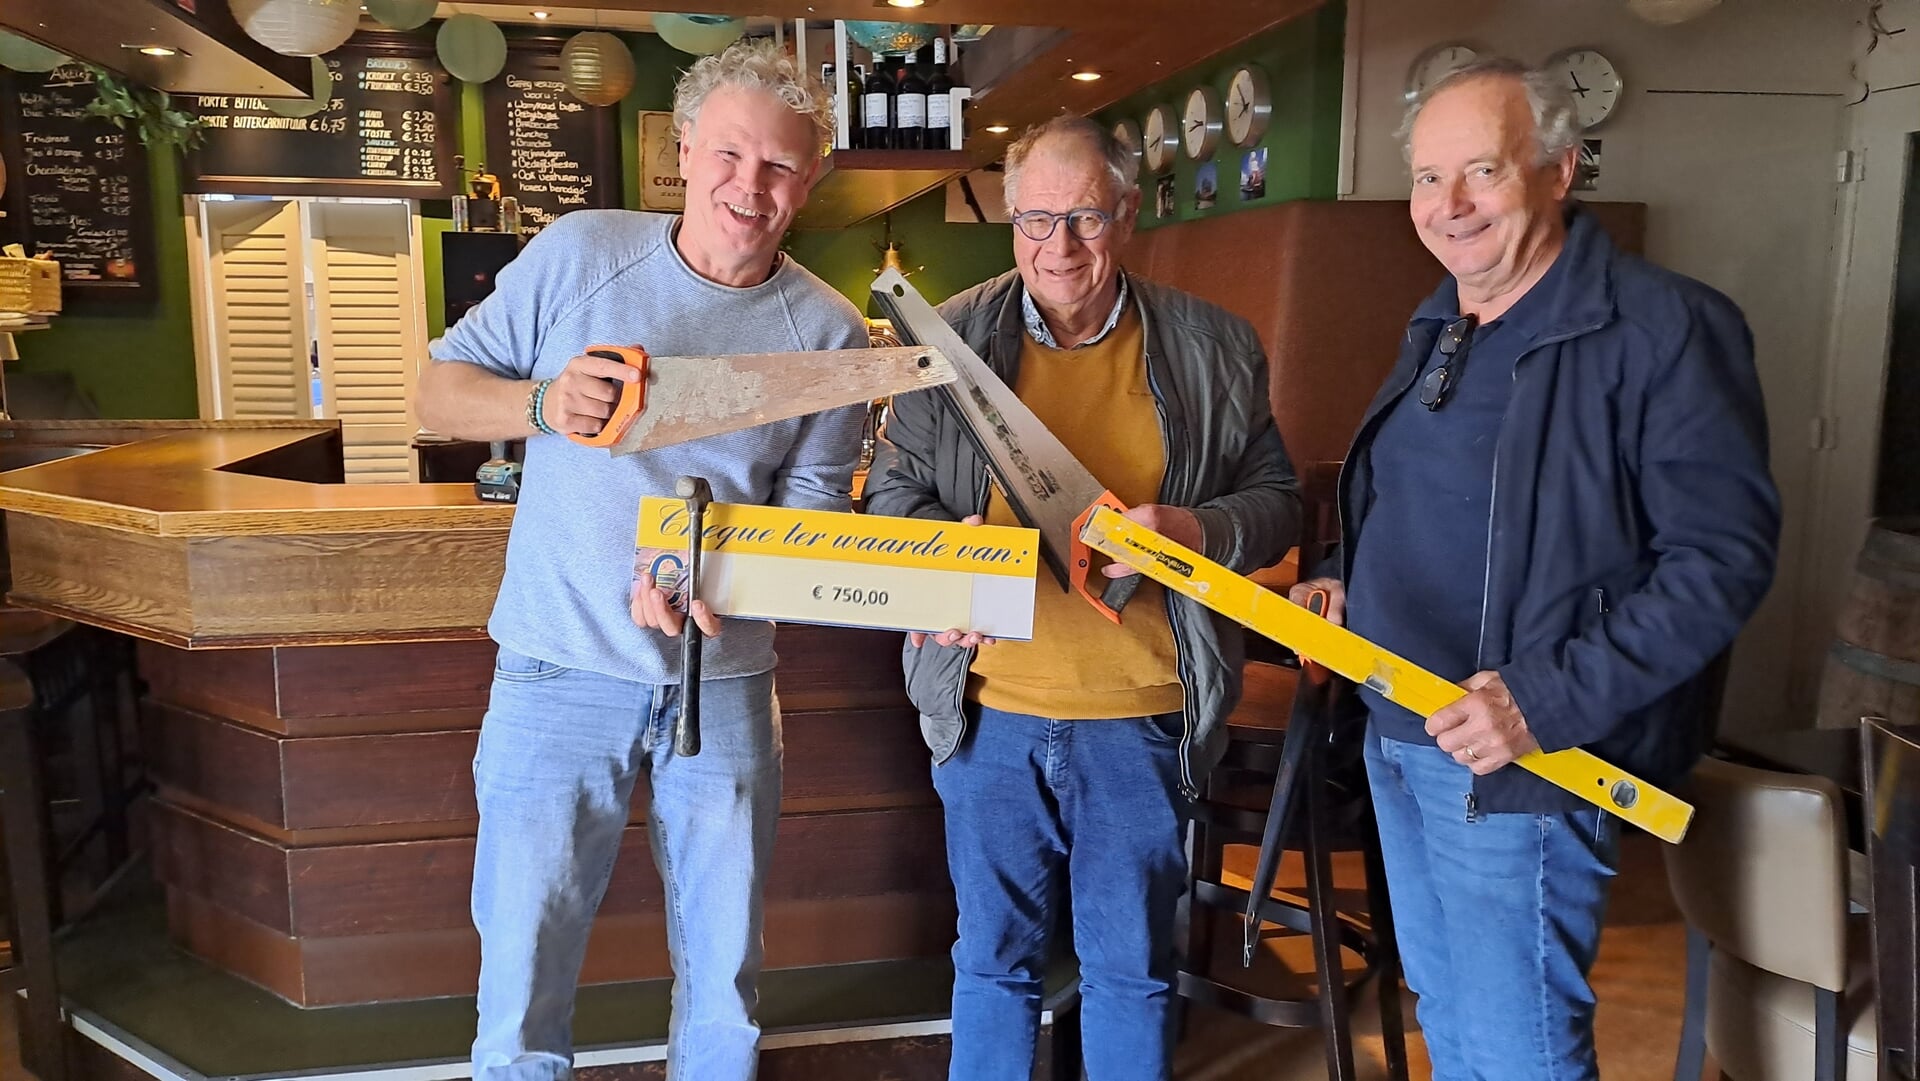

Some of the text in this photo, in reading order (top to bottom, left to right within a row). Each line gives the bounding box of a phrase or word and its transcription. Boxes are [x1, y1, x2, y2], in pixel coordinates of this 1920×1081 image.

[365, 72, 396, 81] KROKET
[233, 116, 308, 130] BITTERGARNITUUR
[365, 120, 384, 128] KAAS
[365, 129, 392, 138] TOSTIE
[518, 169, 536, 181] Ook
[783, 522, 826, 547] ter
[832, 530, 949, 557] waarde
[956, 544, 1028, 564] van:
[812, 585, 889, 606] € 750,00
